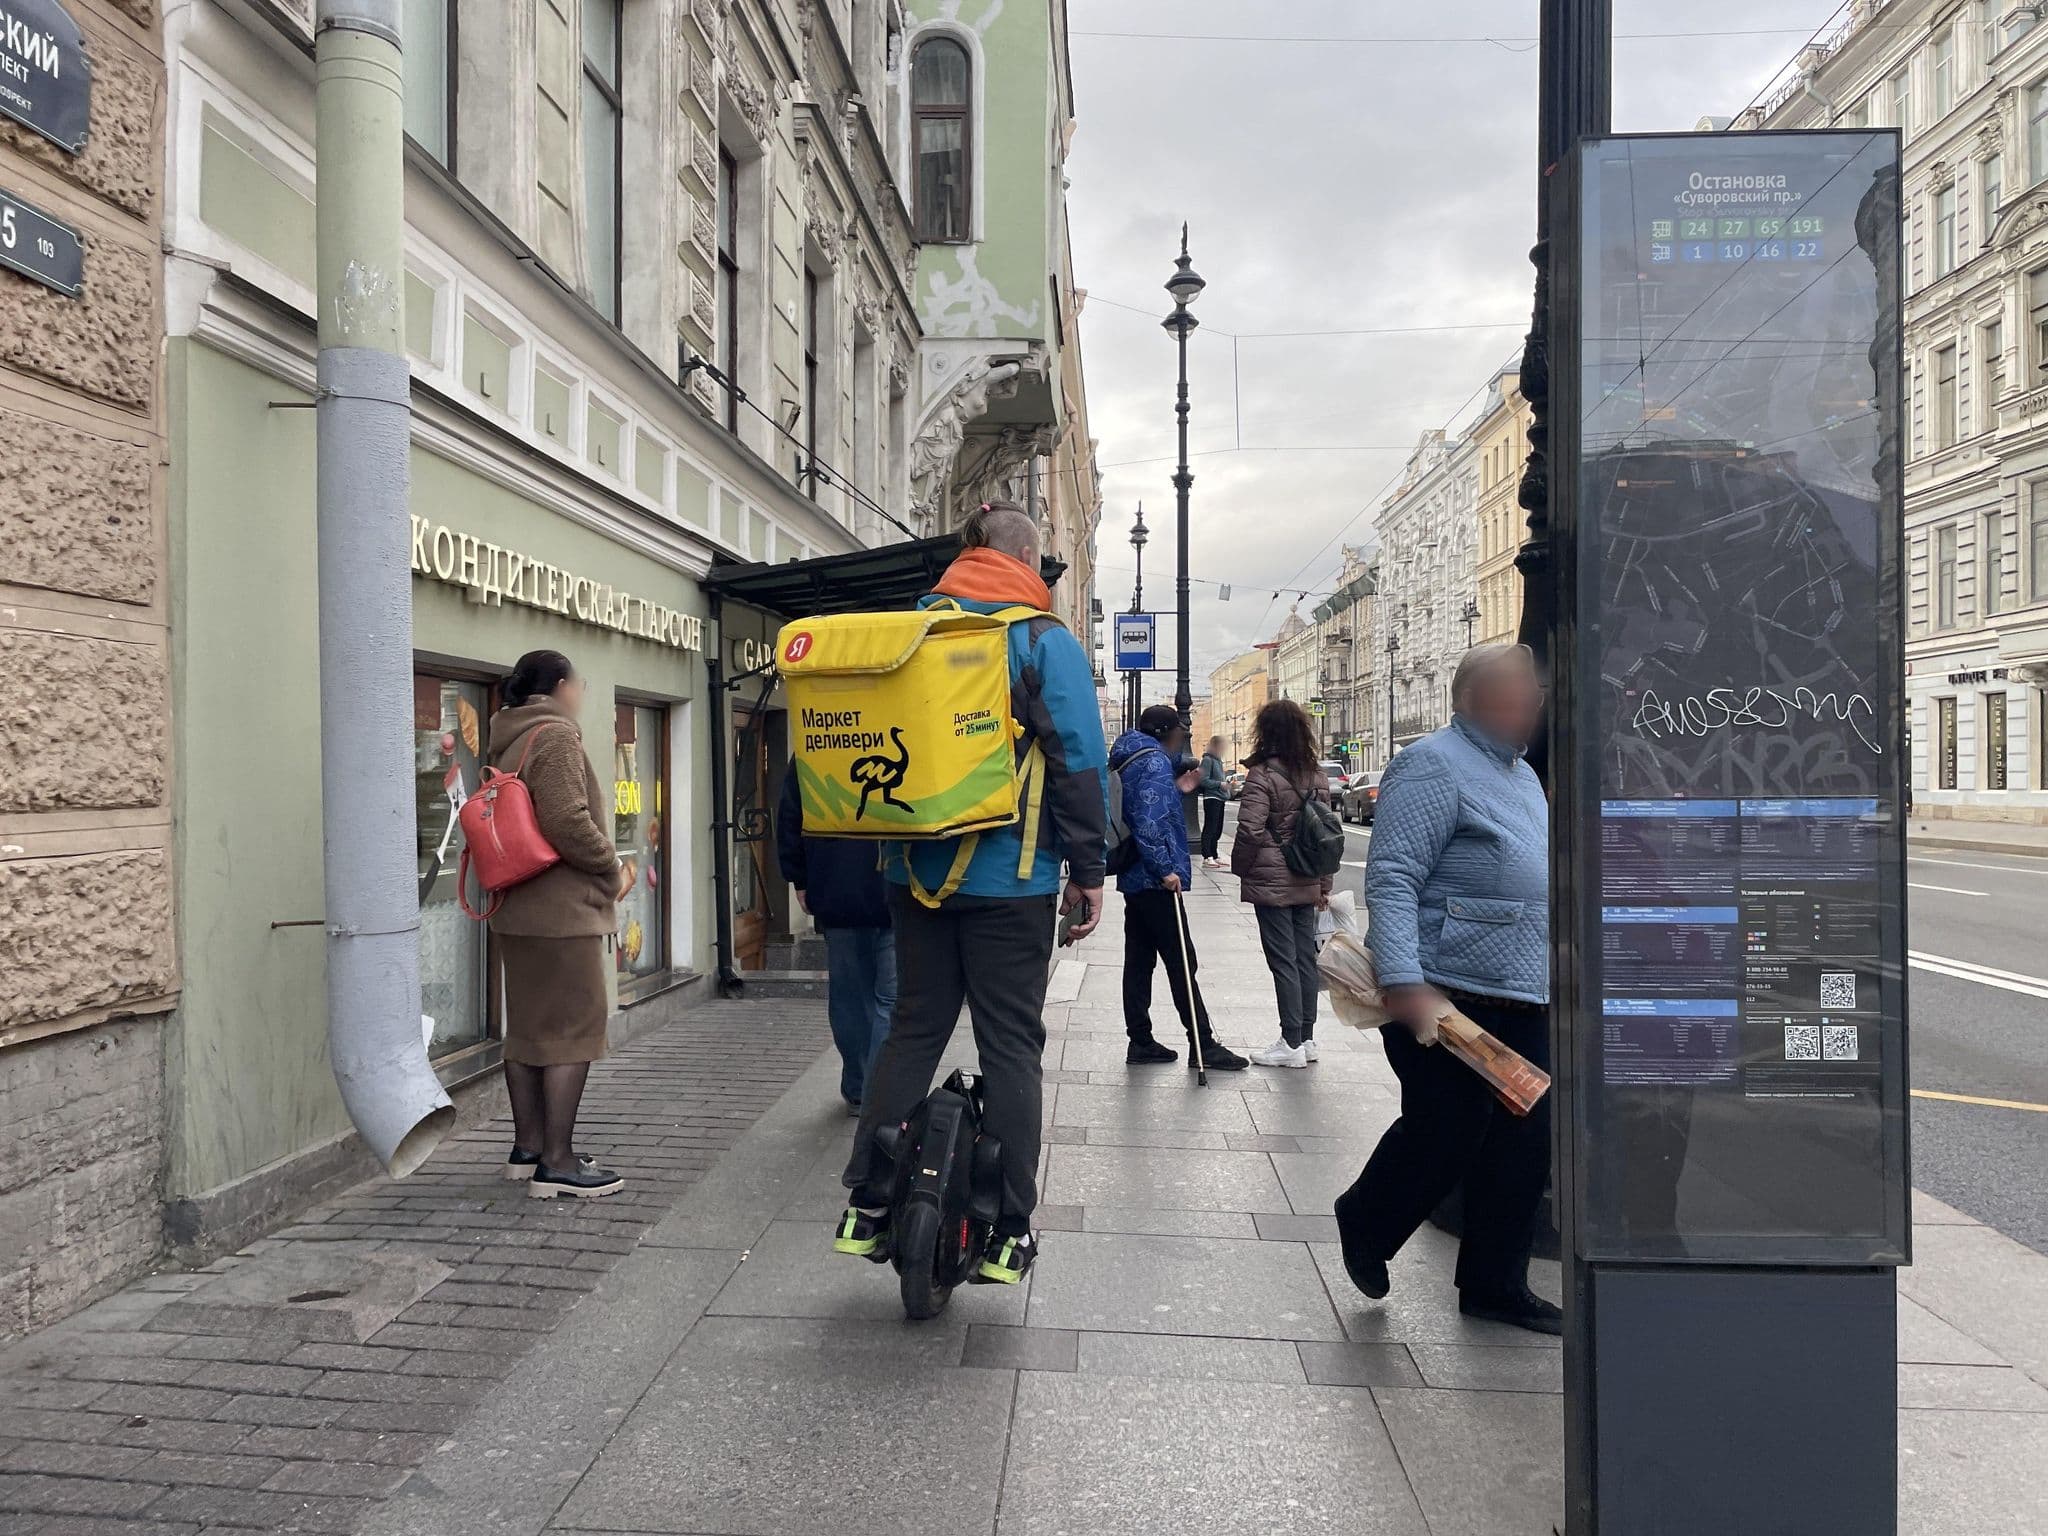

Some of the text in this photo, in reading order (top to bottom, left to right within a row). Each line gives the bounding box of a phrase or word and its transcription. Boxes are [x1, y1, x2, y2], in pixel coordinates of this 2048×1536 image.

[1689, 172, 1787, 190] Остановка
[1673, 189, 1802, 207] «Суворовский пр.»
[1687, 219, 1822, 236] 24 27 65 191
[37, 237, 55, 258] 103
[1693, 243, 1817, 259] 1 10 16 22
[411, 514, 701, 652] КОНДИТЕРСКАЯ ГАРСОН
[791, 637, 806, 657] Я
[744, 638, 778, 686] GAR
[801, 708, 861, 730] Маркет
[954, 709, 991, 726] Доставка
[805, 731, 884, 752] деливери
[955, 728, 964, 737] от
[615, 780, 641, 815] ON
